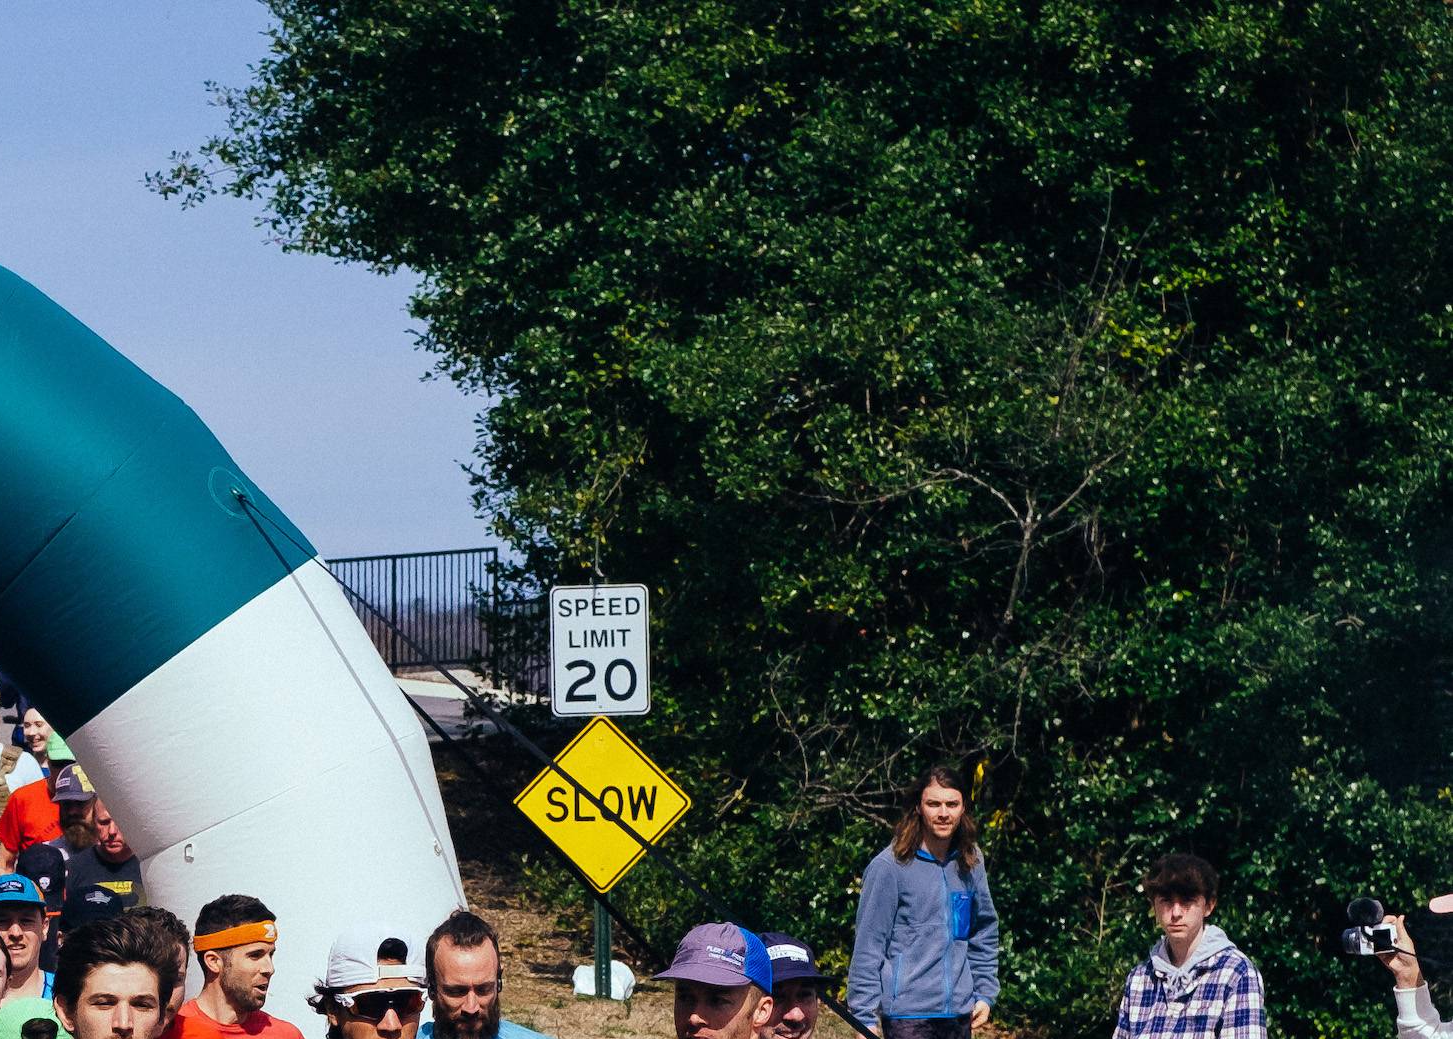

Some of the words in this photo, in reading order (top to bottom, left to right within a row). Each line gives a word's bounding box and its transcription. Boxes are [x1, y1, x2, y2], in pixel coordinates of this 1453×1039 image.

[558, 597, 641, 617] SPEED
[568, 629, 631, 649] LIMIT
[565, 659, 637, 702] 20
[546, 786, 657, 823] SLOW
